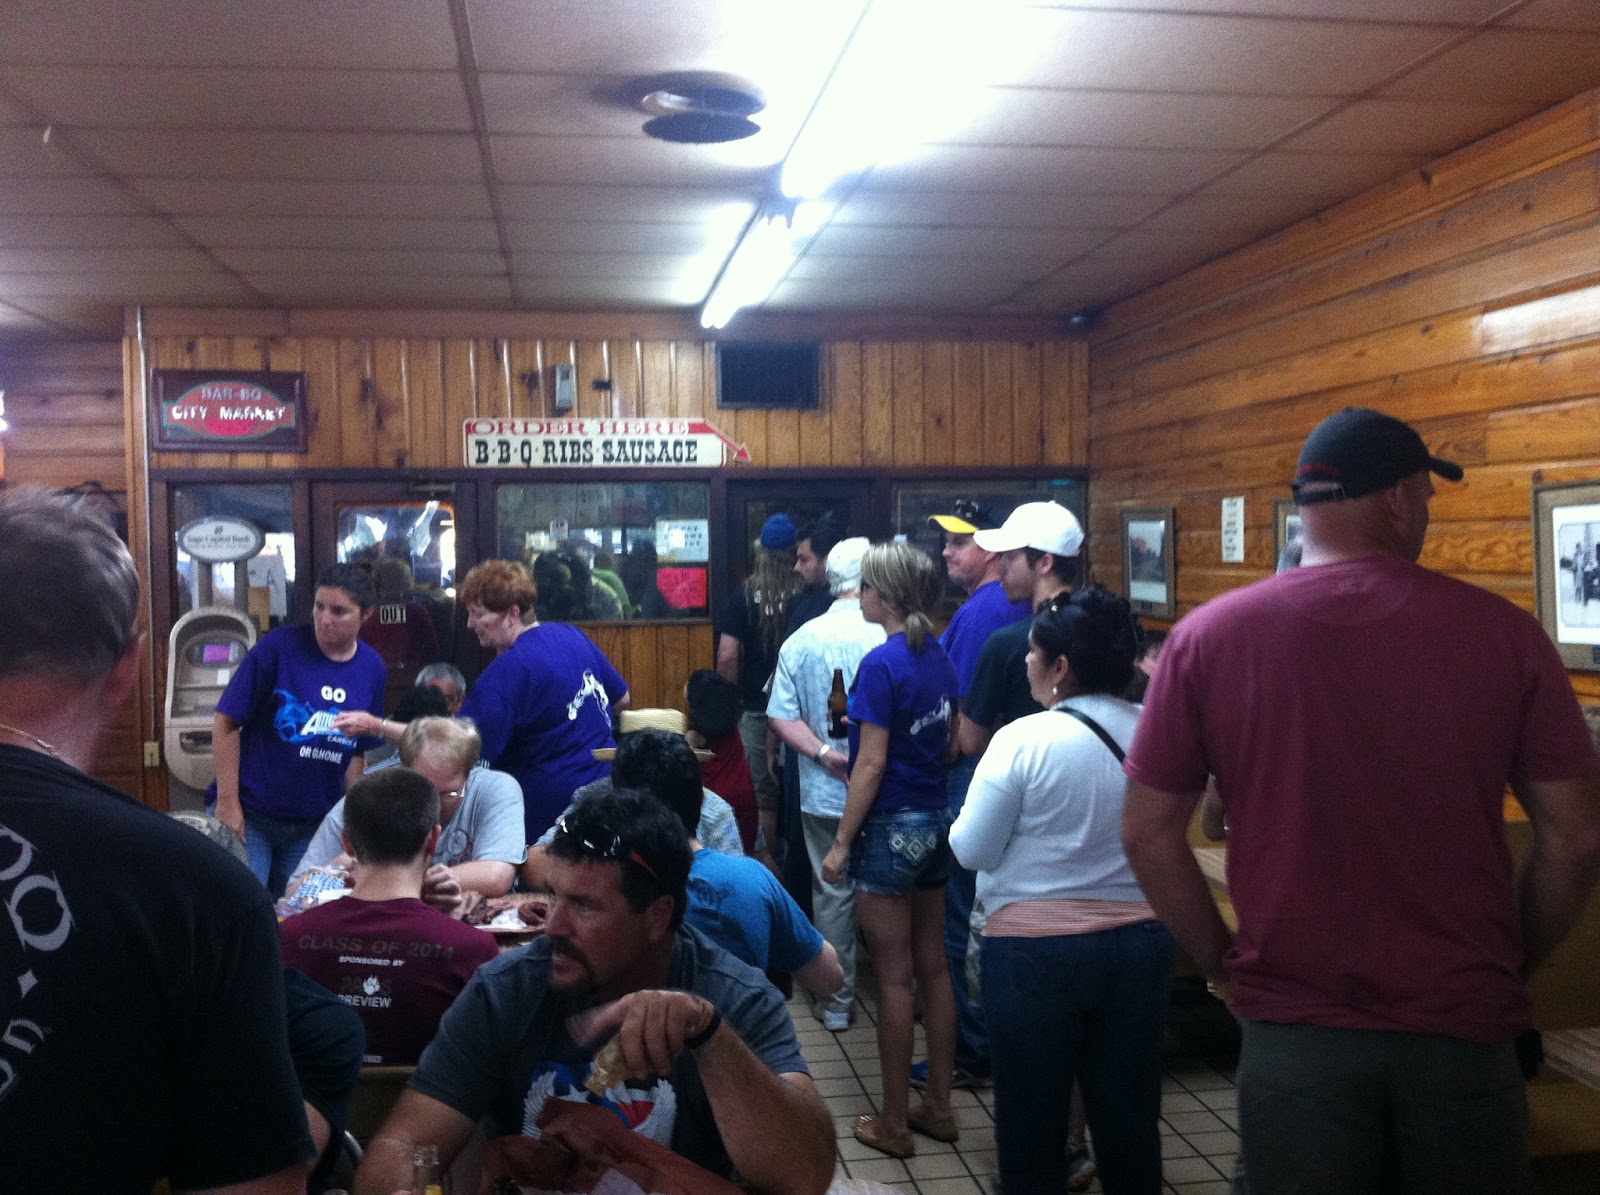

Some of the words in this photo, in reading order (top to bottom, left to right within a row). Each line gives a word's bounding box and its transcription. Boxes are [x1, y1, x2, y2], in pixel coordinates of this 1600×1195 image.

[171, 404, 209, 420] CITY
[219, 404, 286, 421] MARKET
[468, 419, 588, 436] ORDER
[600, 419, 689, 435] HERE
[381, 606, 404, 623] OUT
[321, 685, 346, 703] GO
[300, 745, 312, 758] OR
[298, 934, 363, 953] CLASS
[371, 939, 400, 954] OF
[338, 956, 391, 967] SPONSORED
[392, 959, 406, 967] BY
